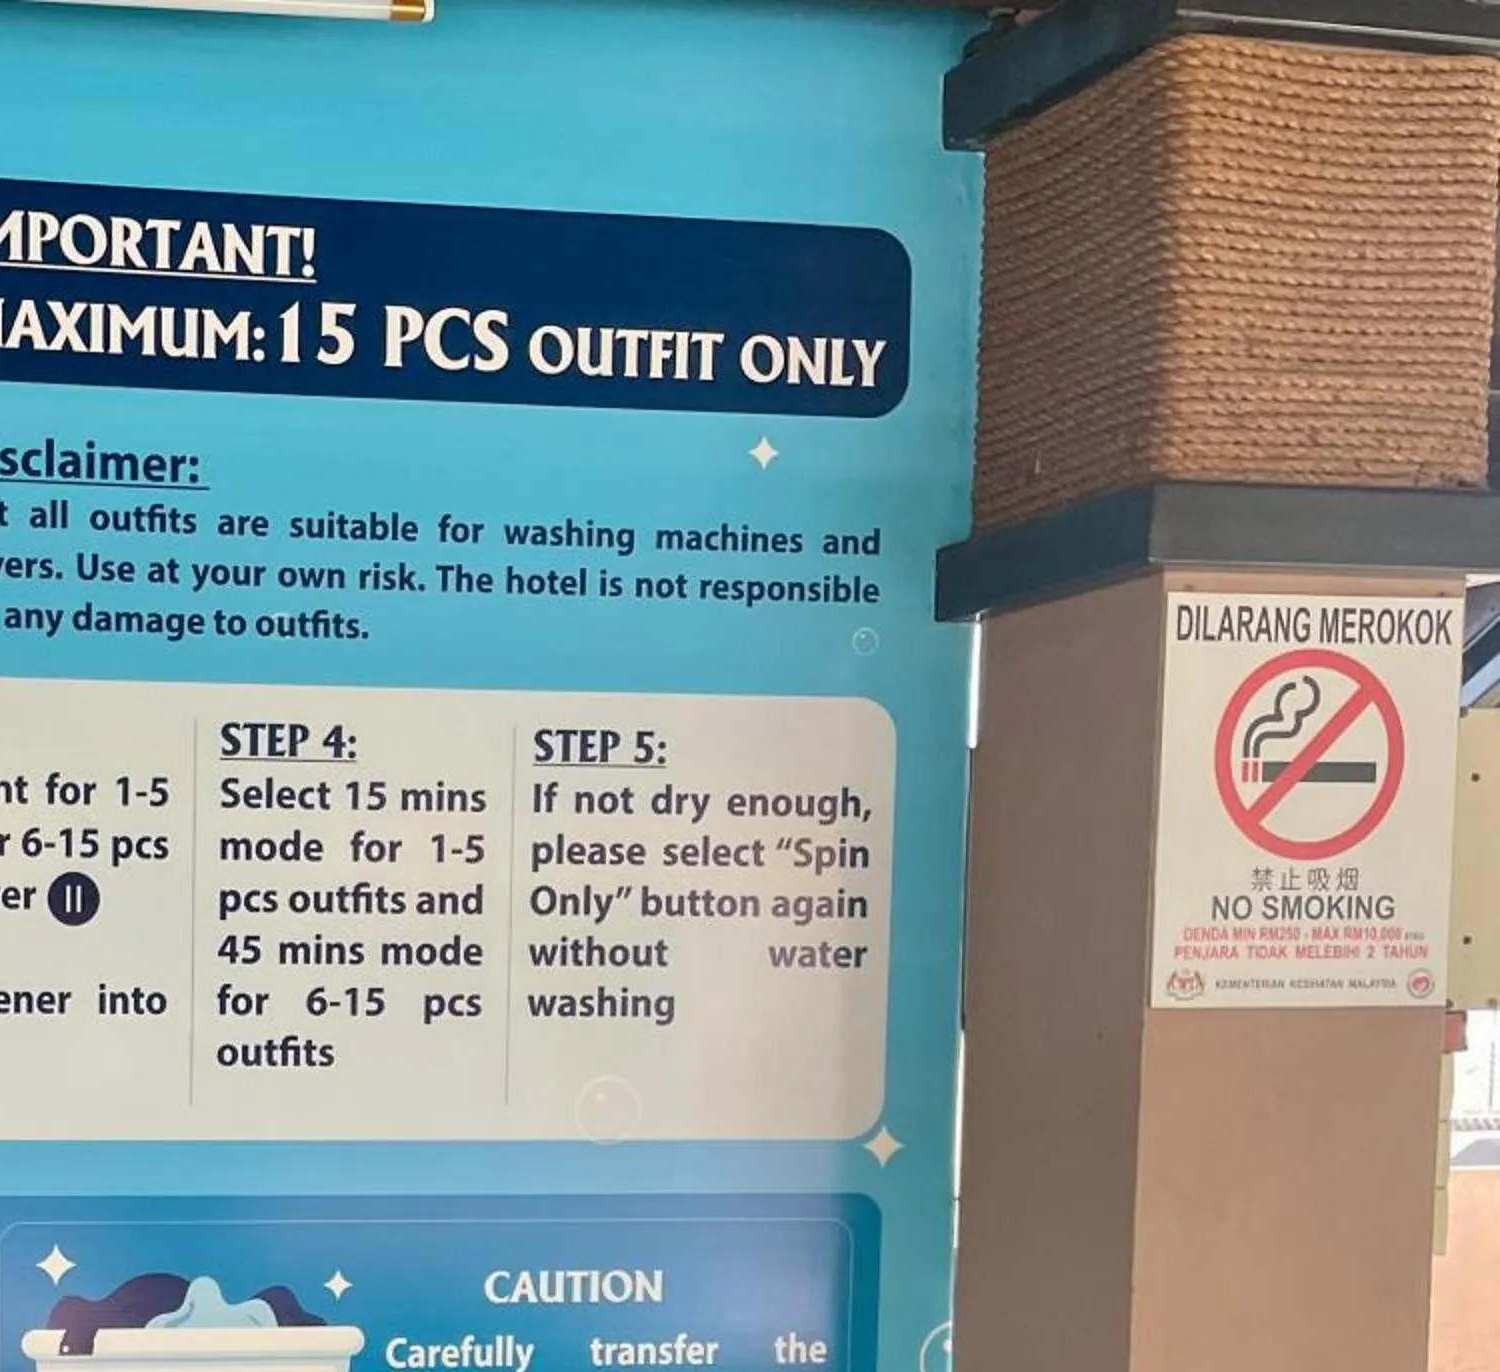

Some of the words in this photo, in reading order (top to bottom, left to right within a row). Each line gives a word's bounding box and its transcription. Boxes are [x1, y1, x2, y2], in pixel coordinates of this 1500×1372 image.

[384, 305, 509, 372] PCS
[529, 325, 725, 381] OUTFIT
[740, 334, 887, 387] ONLY
[29, 499, 68, 529] all
[89, 503, 197, 535] outfits
[217, 514, 269, 537] are
[289, 510, 419, 542] suitable
[437, 513, 485, 544] for
[503, 517, 635, 557] washing
[655, 522, 803, 554] machines
[822, 527, 881, 556] and
[3, 607, 65, 638] any
[71, 601, 206, 642] damage
[213, 609, 247, 637] to
[255, 609, 369, 640] outfits.
[1176, 604, 1311, 644] DILARANG
[1319, 607, 1453, 646] MEROKOK
[220, 722, 310, 757] STEP
[322, 724, 357, 759] 4:
[533, 728, 621, 763] STEP
[633, 730, 667, 765] 5:
[45, 771, 97, 806] for
[116, 776, 169, 807] 1-5
[220, 776, 331, 811] Select
[345, 780, 387, 811] 15
[401, 780, 487, 813] mins
[533, 781, 559, 813] If
[574, 786, 635, 815] not
[651, 783, 711, 825] dry
[727, 786, 872, 826] enough,
[1251, 865, 1360, 893] 禁止吸烟
[219, 889, 279, 921] pcs
[288, 881, 407, 915] outfits
[415, 883, 483, 915] and
[641, 885, 760, 918] button
[771, 887, 869, 926] again
[1211, 895, 1253, 921] NO
[1261, 894, 1395, 921] SMOKING
[217, 935, 261, 965] 45
[279, 933, 365, 965] mins
[381, 934, 483, 966] mode
[528, 935, 669, 967] without
[768, 941, 869, 969] water
[1174, 946, 1238, 959] PENJARA
[1249, 945, 1286, 958] TIDAK
[1367, 945, 1375, 958] 2
[1384, 945, 1428, 958] TAHUN
[1183, 928, 1229, 941] DENDA
[1232, 928, 1256, 941] MIN
[1311, 928, 1339, 941] MAX
[216, 983, 270, 1016] for
[306, 986, 385, 1017] 6-15
[423, 993, 482, 1025] pcs
[527, 985, 675, 1026] washing
[216, 1034, 335, 1067] outfits
[484, 1269, 663, 1304] CAUTION
[589, 1332, 720, 1366] transfer
[773, 1331, 827, 1364] the
